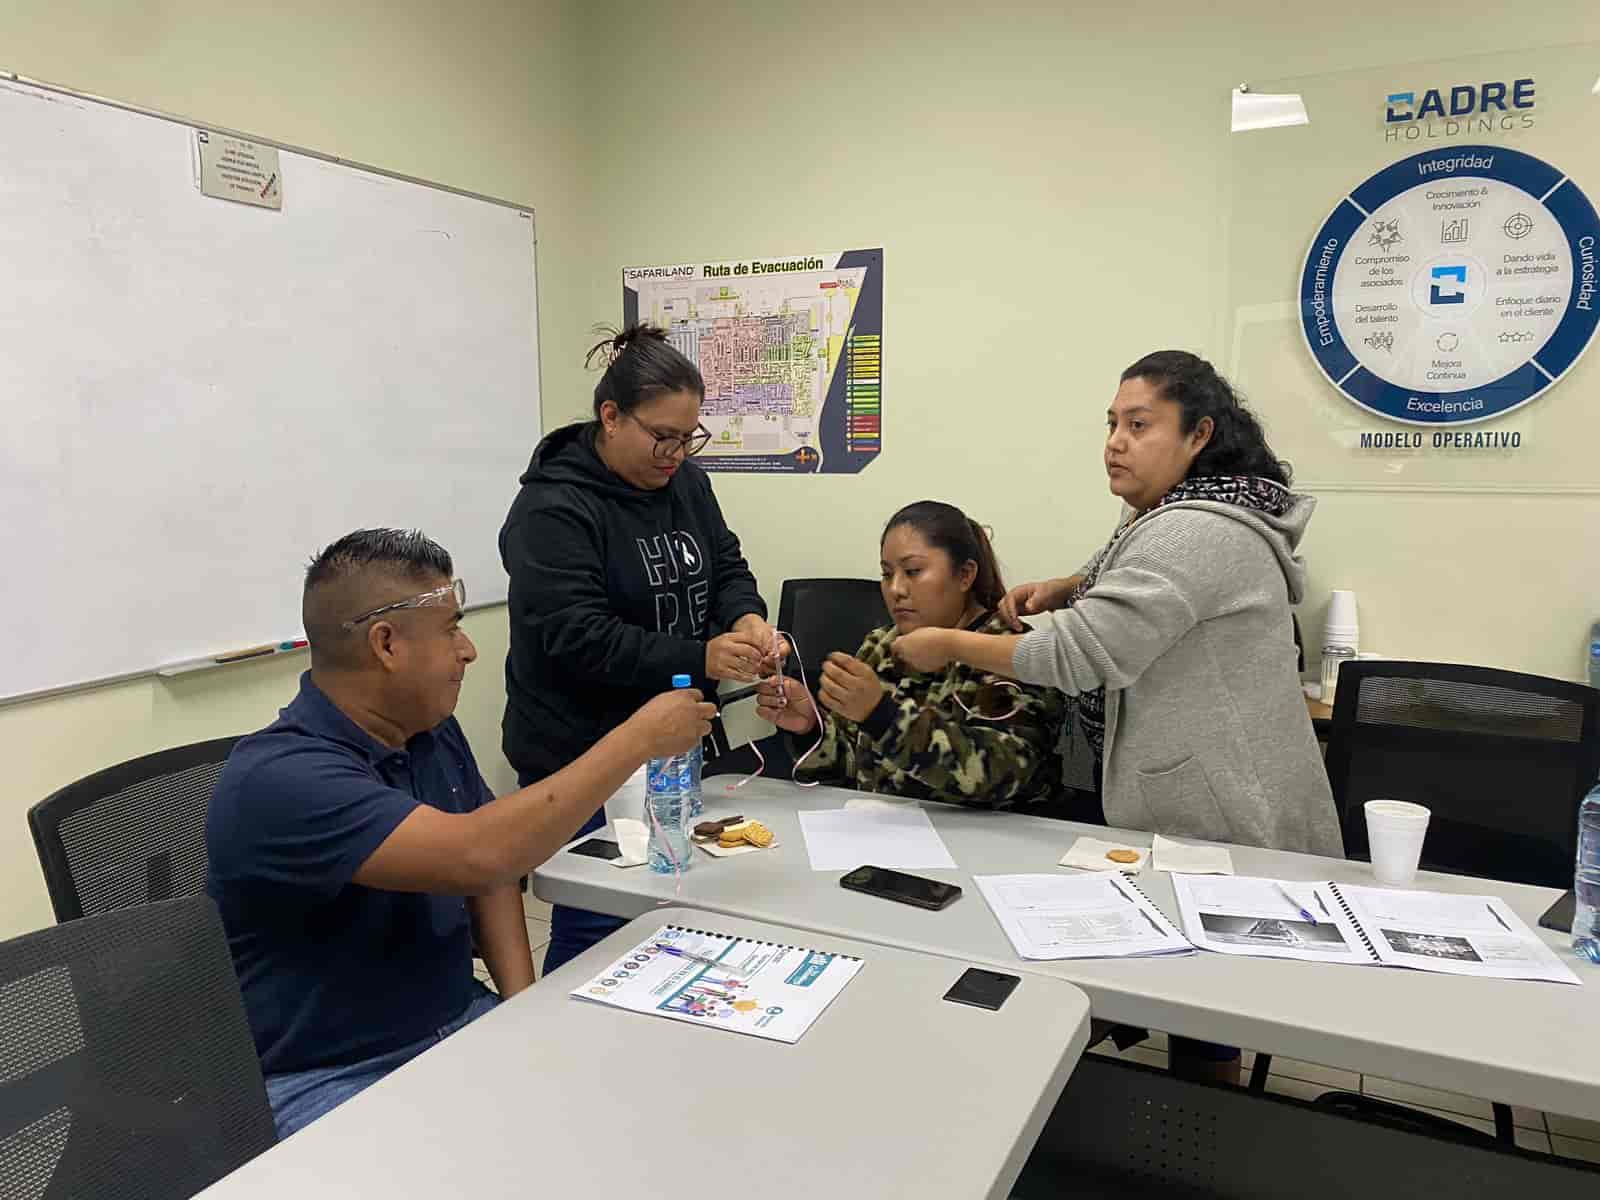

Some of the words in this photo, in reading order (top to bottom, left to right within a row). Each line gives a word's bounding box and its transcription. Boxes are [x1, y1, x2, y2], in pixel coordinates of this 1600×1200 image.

[1386, 79, 1535, 122] CADRE
[1385, 113, 1535, 143] HOLDINGS
[1418, 153, 1494, 175] Integridad
[1426, 189, 1480, 200] Crecimiento
[1480, 187, 1488, 195] &
[1432, 200, 1481, 211] Innovación
[1355, 255, 1410, 265] Compromiso
[1503, 253, 1534, 263] Dando
[1536, 251, 1556, 261] vida
[630, 267, 693, 279] SAFARILAND
[703, 263, 731, 278] Ruta
[733, 262, 749, 275] de
[752, 257, 823, 274] Evacuación
[1369, 267, 1380, 276] de
[1382, 267, 1395, 275] los
[1504, 266, 1512, 275] la
[1514, 263, 1559, 275] estrategia
[1576, 236, 1598, 310] Curiosidad
[1360, 278, 1404, 288] asociados
[1310, 238, 1339, 347] Empoderamiento
[1496, 296, 1533, 307] Enfoque
[1535, 294, 1561, 304] diario
[1355, 303, 1398, 313] Desarrollo
[1500, 310, 1512, 318] en
[1514, 308, 1522, 317] el
[1523, 307, 1553, 317] cliente
[1355, 314, 1368, 324] del
[1370, 313, 1398, 324] talento
[1432, 360, 1462, 370] Mejora
[1426, 370, 1466, 380] Continua
[1407, 397, 1484, 413] Excelencia
[1360, 432, 1422, 448] MODELO
[1433, 431, 1521, 448] OPERATIVO
